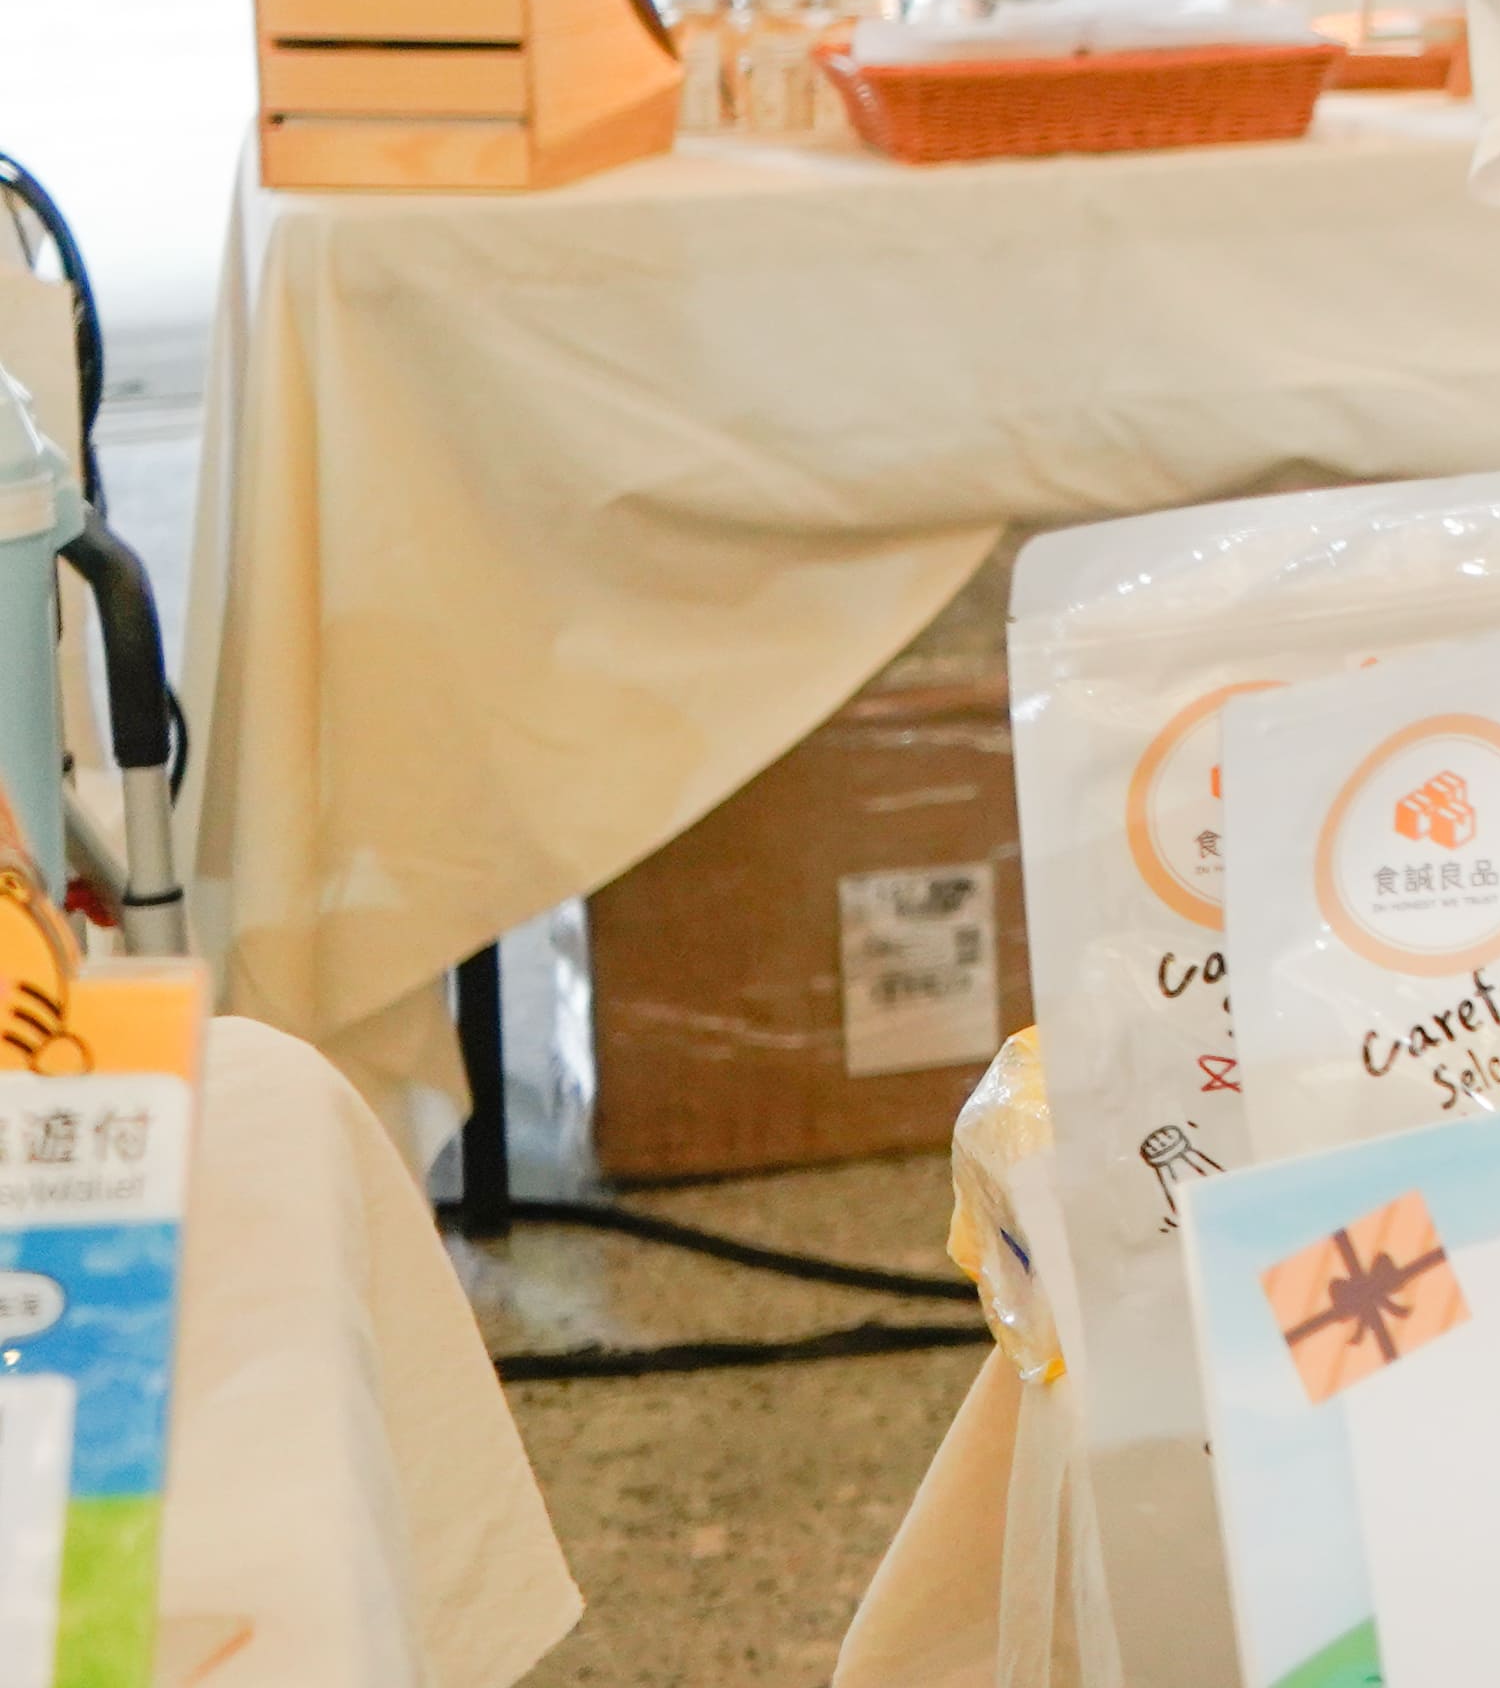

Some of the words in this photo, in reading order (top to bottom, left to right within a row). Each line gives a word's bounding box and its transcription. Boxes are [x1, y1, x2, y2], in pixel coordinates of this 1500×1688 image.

[1374, 859, 1499, 896] 食誠良品
[0, 1108, 150, 1164] 遊付
